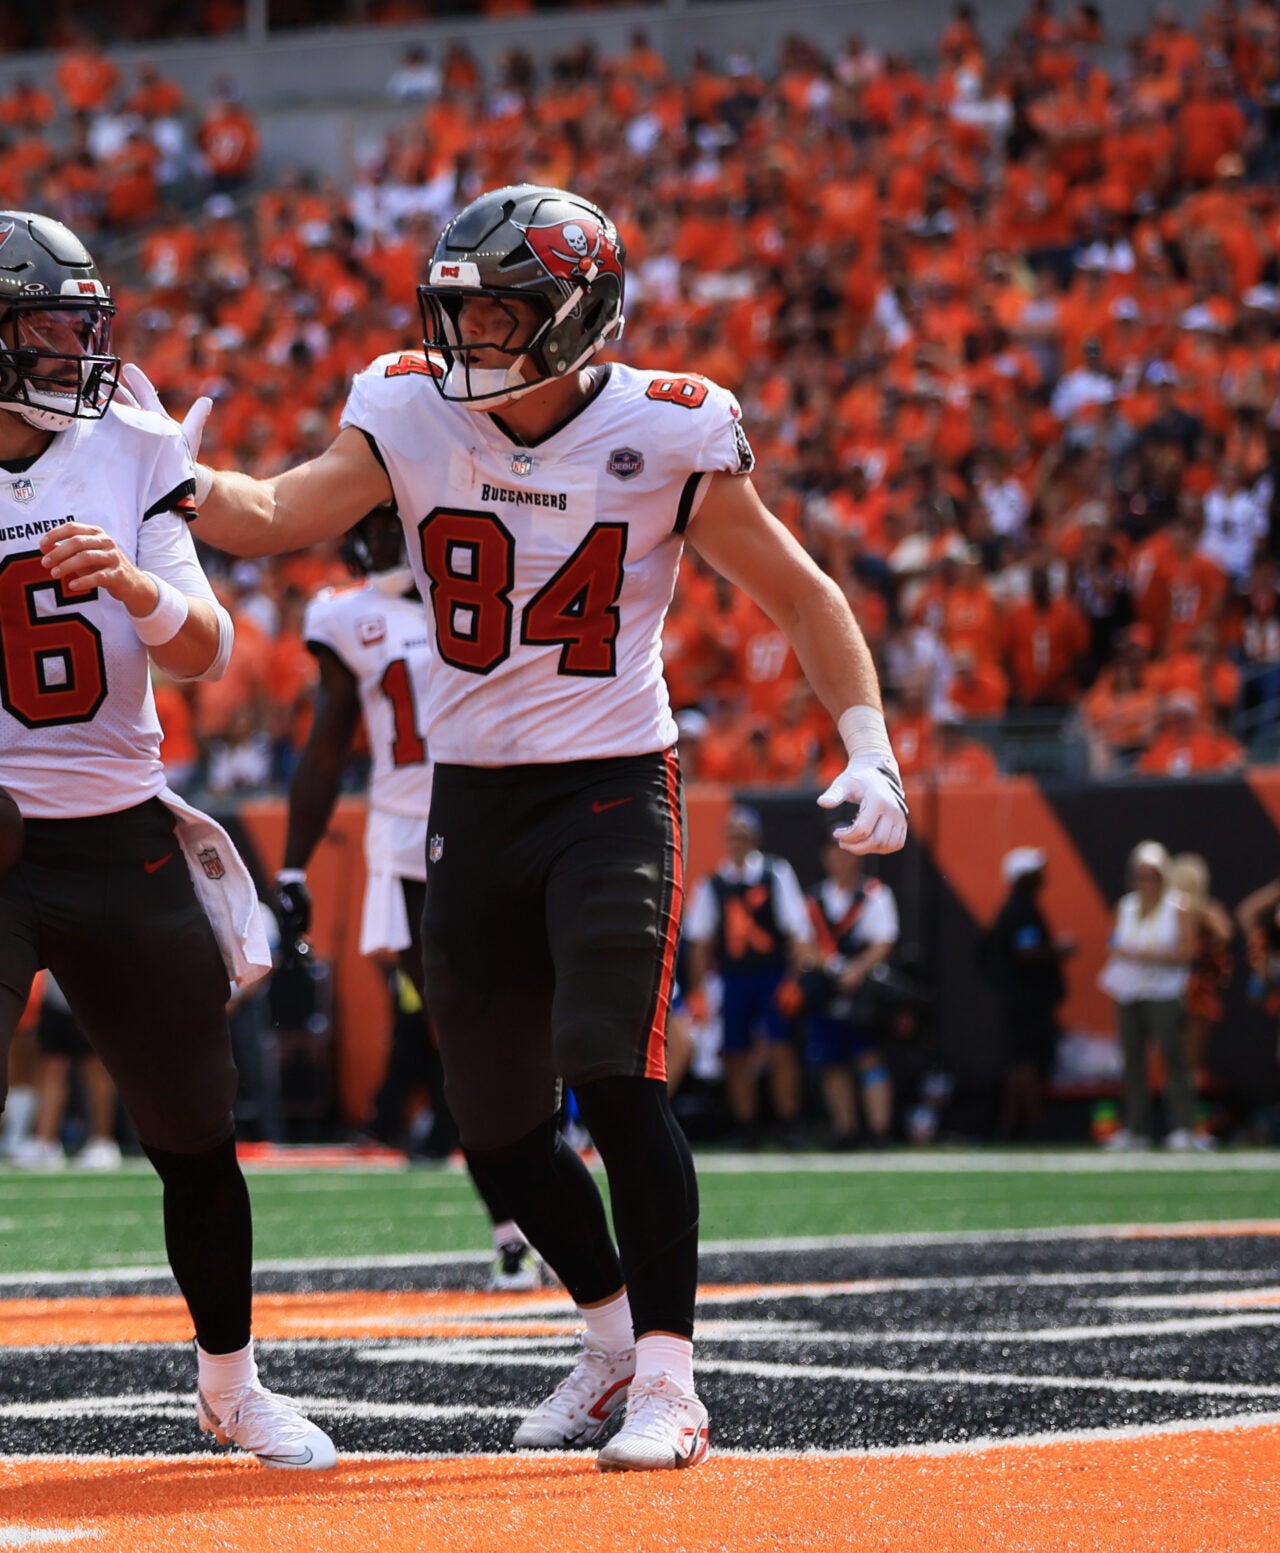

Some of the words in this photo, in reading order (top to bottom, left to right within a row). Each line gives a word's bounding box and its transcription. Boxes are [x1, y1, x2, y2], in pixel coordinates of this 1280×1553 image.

[16, 488, 33, 499] NFL
[481, 483, 568, 511] BUCCANEERS
[417, 505, 629, 678] 84
